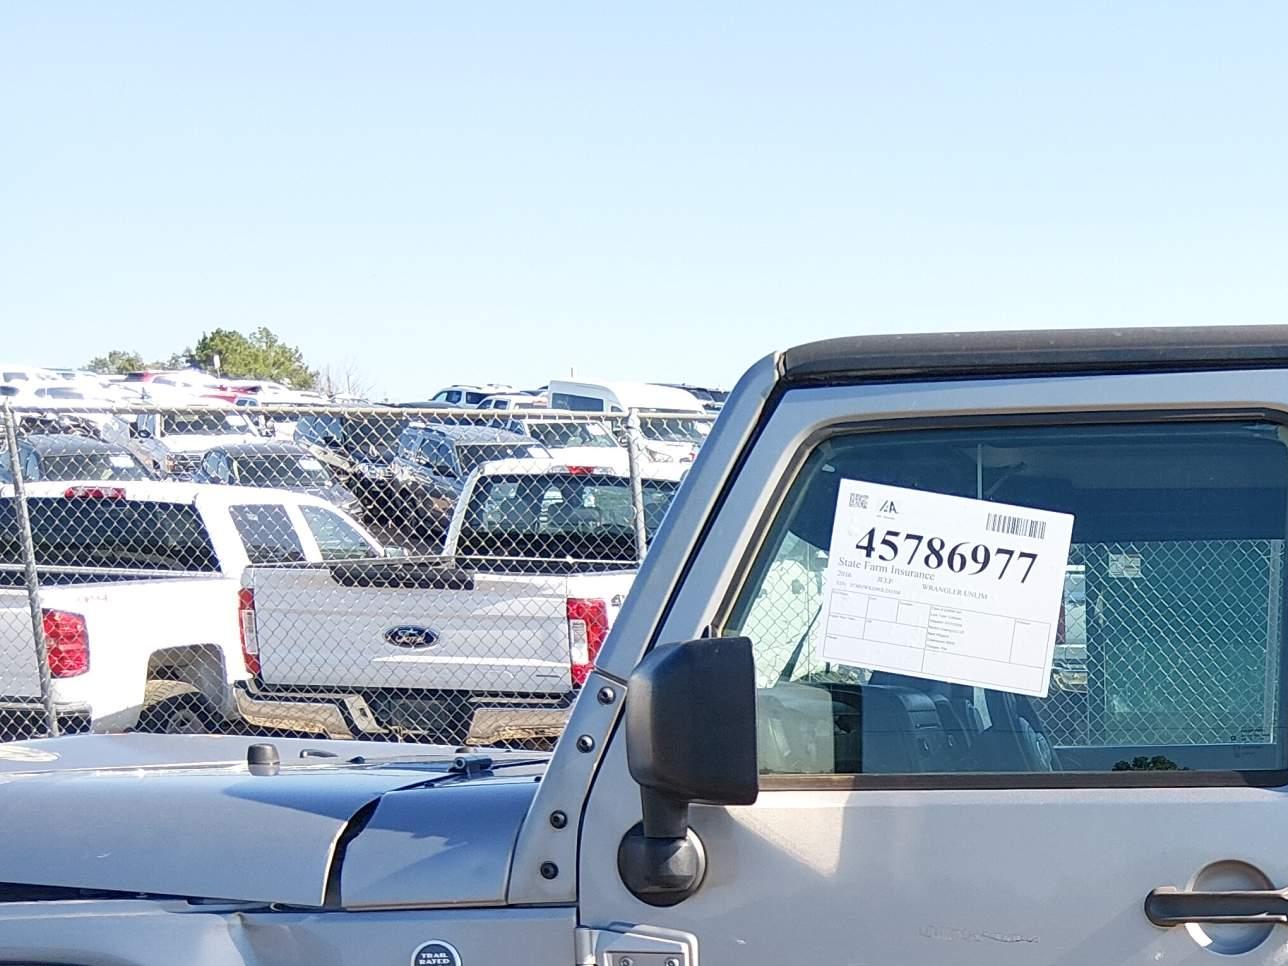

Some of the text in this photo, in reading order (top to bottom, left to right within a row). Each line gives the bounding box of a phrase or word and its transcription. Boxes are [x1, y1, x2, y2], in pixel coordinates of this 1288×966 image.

[855, 526, 1039, 584] 45786977
[838, 556, 936, 582] State Farm Insurance
[922, 583, 962, 598] WRANGLER
[963, 589, 988, 602] UNLIM
